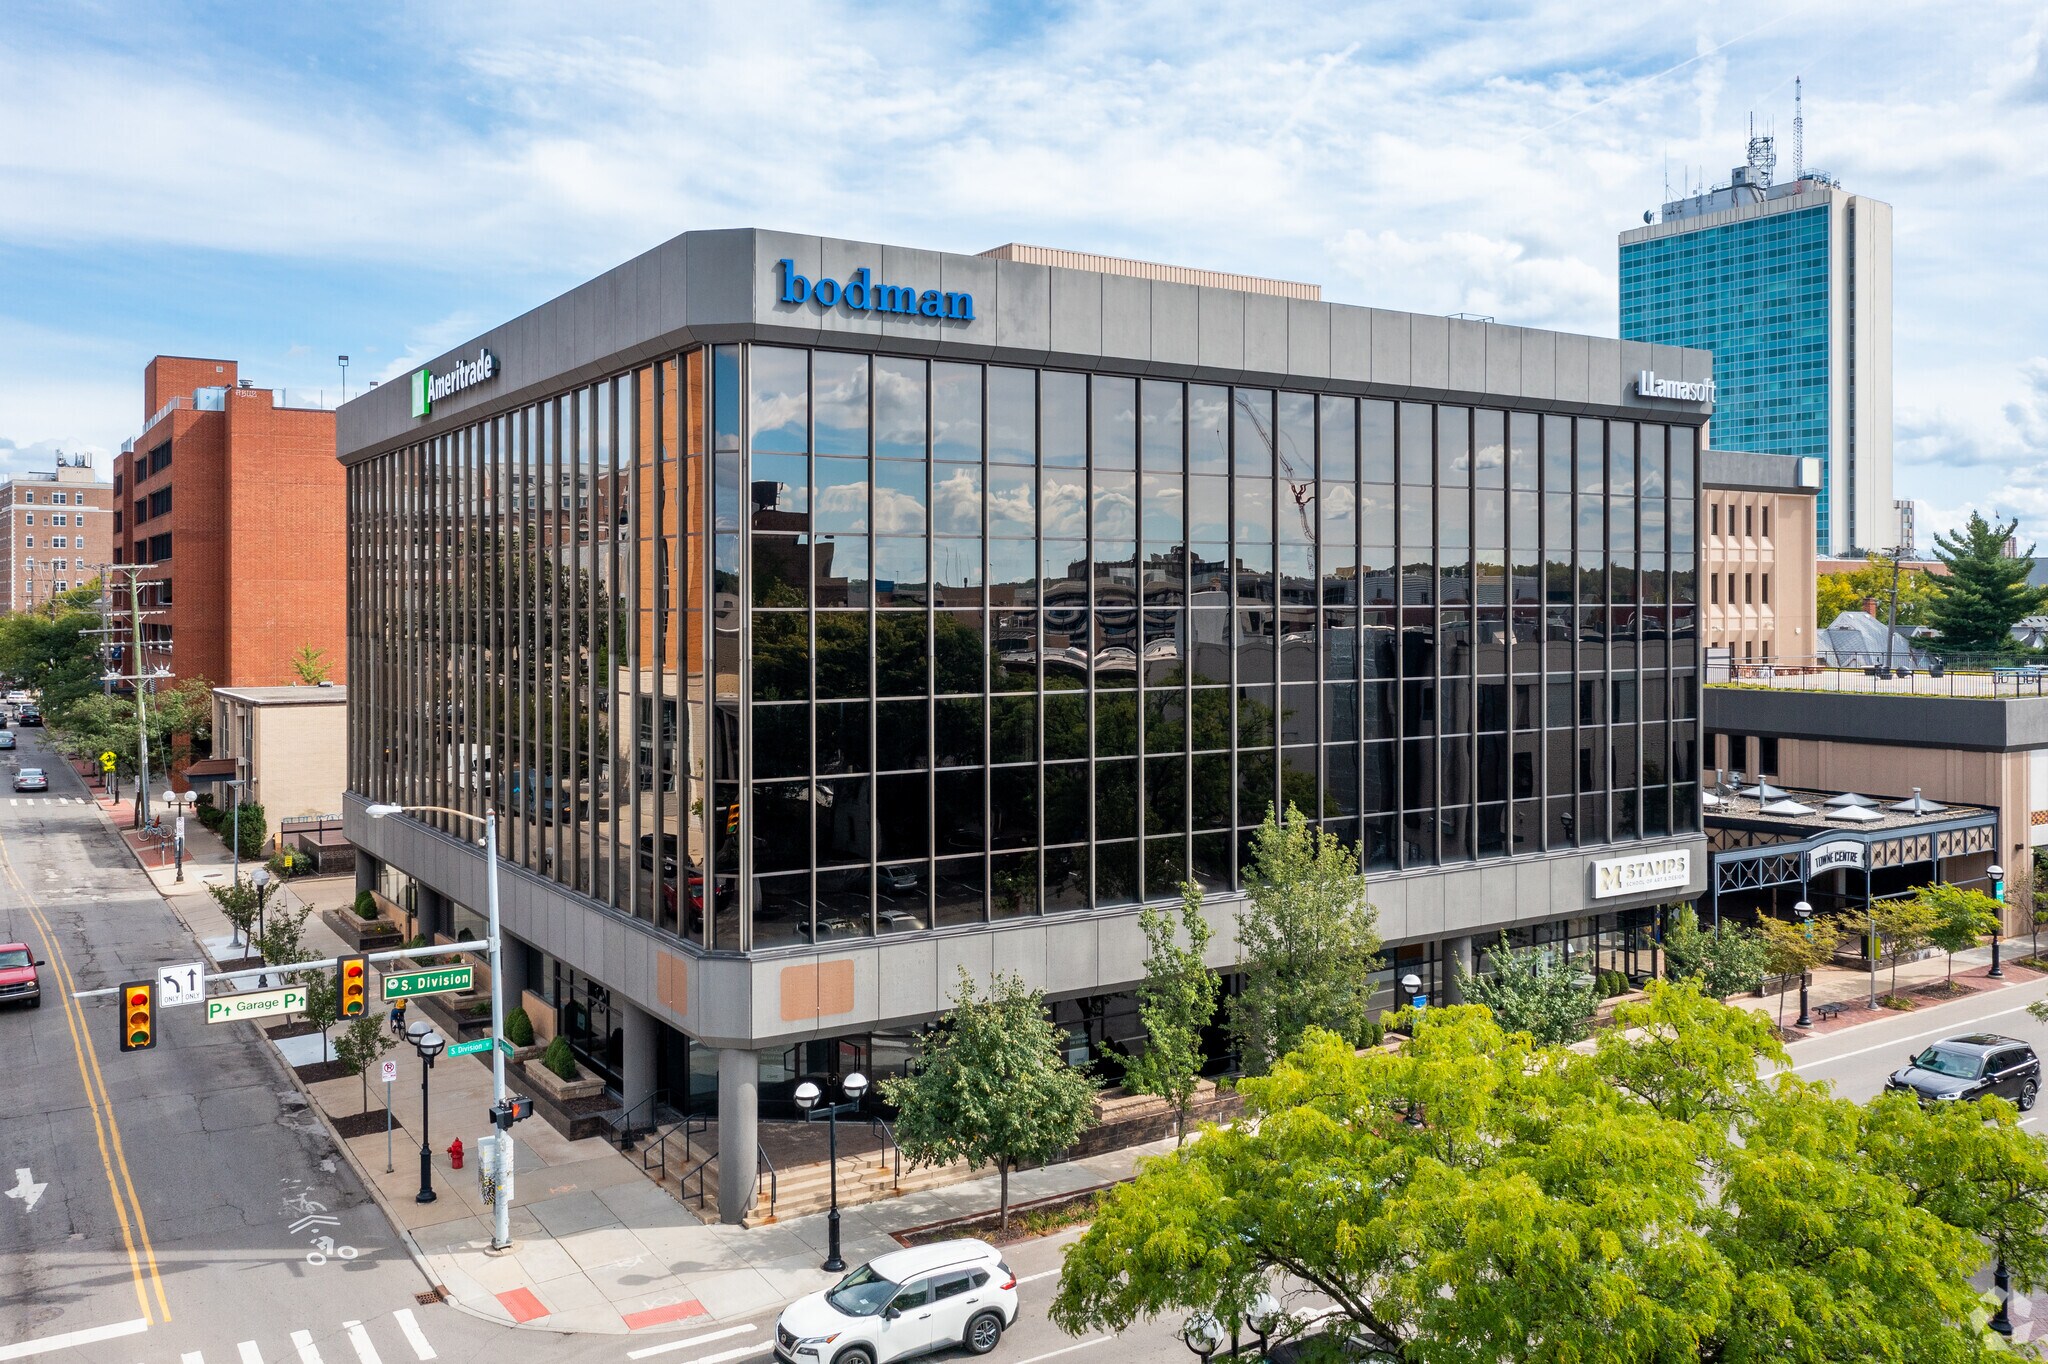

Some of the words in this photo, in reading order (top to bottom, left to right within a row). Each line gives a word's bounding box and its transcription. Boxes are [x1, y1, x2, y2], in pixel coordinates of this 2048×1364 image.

[780, 259, 976, 320] bodman
[427, 348, 492, 403] Ameritrade
[1626, 857, 1685, 879] STAMPS
[1815, 852, 1833, 867] TOWNE
[1835, 851, 1858, 863] CENTRE
[1601, 865, 1622, 890] M
[401, 979, 412, 991] S.
[417, 974, 469, 989] Division
[164, 995, 179, 1004] ONLY
[185, 992, 200, 1000] ONLY
[210, 1003, 222, 1018] P
[236, 998, 279, 1012] Garage
[284, 993, 296, 1008] P
[451, 1047, 456, 1055] S
[457, 1043, 483, 1054] Division
